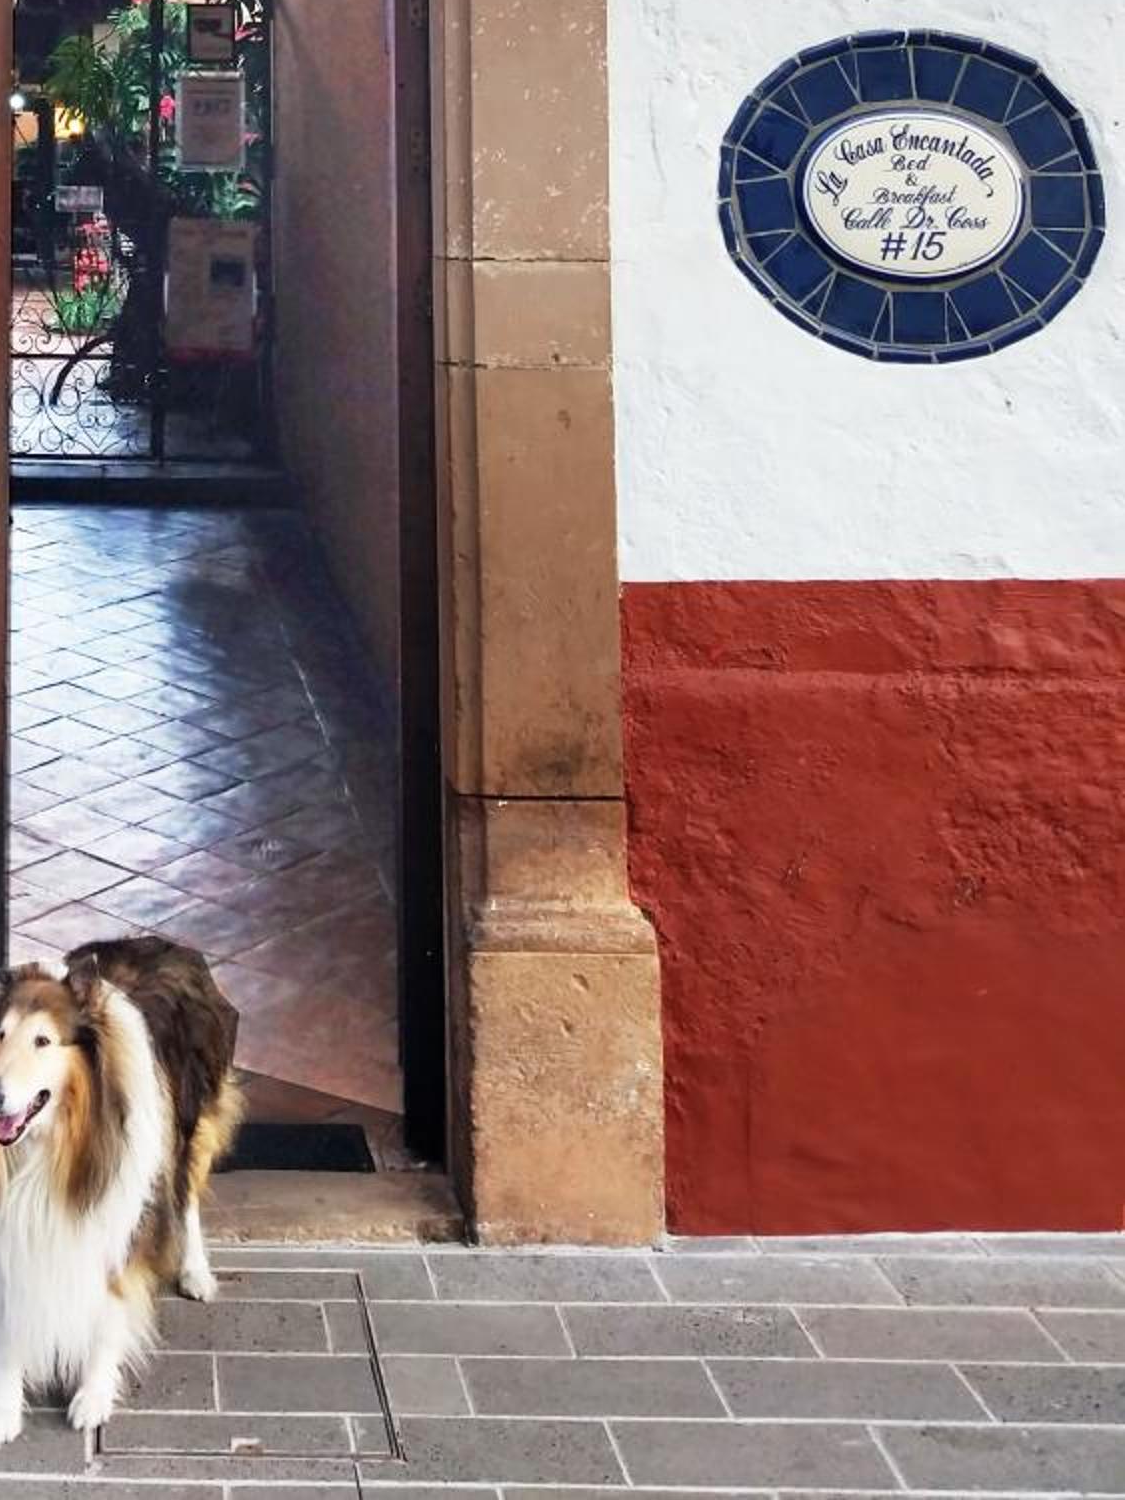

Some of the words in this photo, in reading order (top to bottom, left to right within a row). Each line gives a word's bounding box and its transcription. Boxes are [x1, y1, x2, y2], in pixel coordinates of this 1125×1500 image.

[815, 170, 849, 206] La
[834, 139, 884, 166] Casa
[890, 123, 995, 197] Encantada
[886, 153, 931, 171] Bed
[904, 171, 918, 187] &
[868, 184, 958, 209] Breakfast
[880, 231, 947, 261] #15
